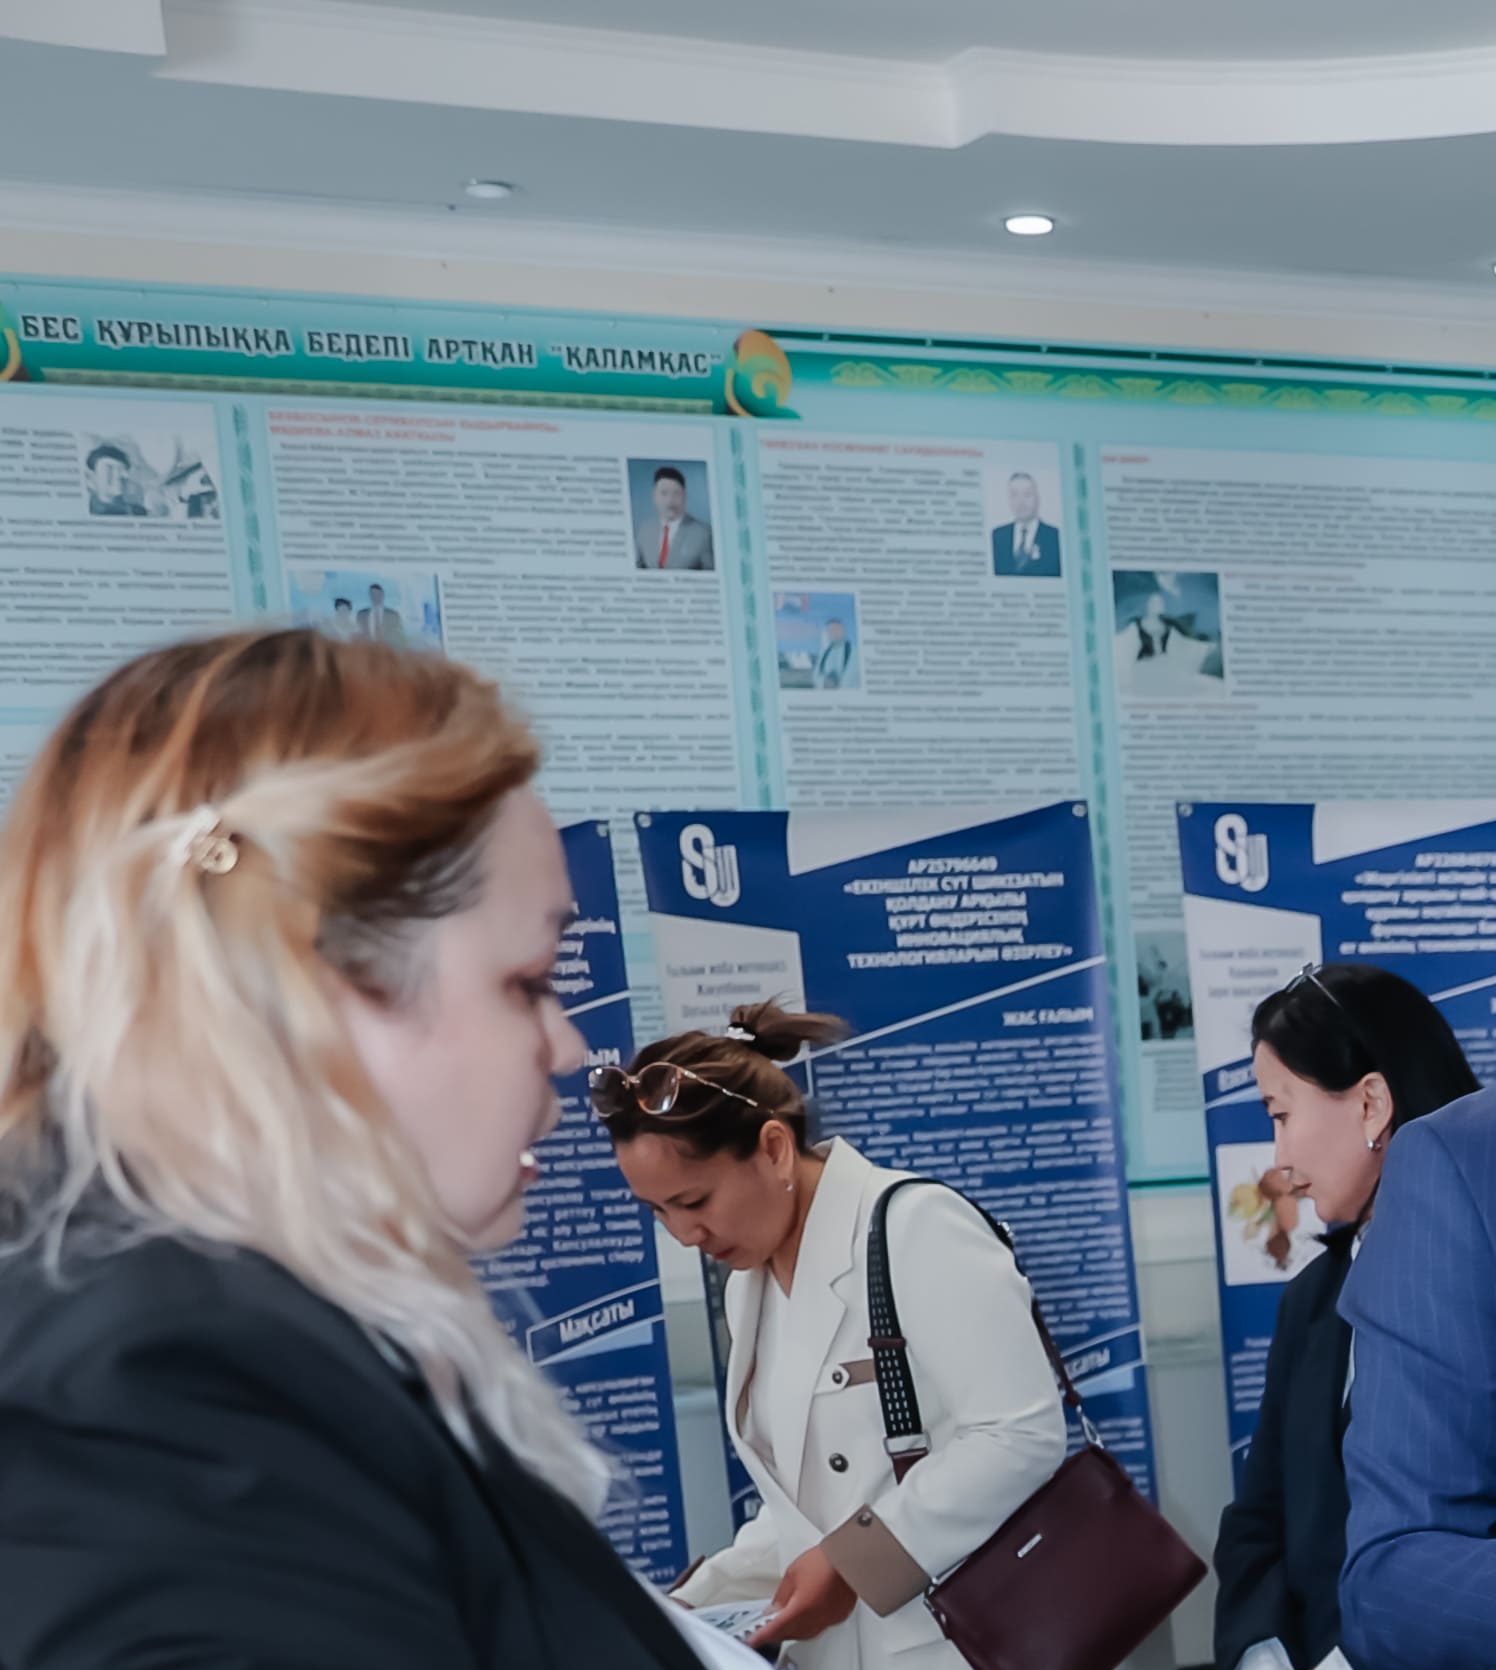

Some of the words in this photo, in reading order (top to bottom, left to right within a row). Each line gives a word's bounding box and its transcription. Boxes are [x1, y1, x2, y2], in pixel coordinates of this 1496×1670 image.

[20, 314, 79, 341] БЕС
[427, 337, 534, 366] АРТҚАН
[558, 1298, 635, 1344] Мақсаты
